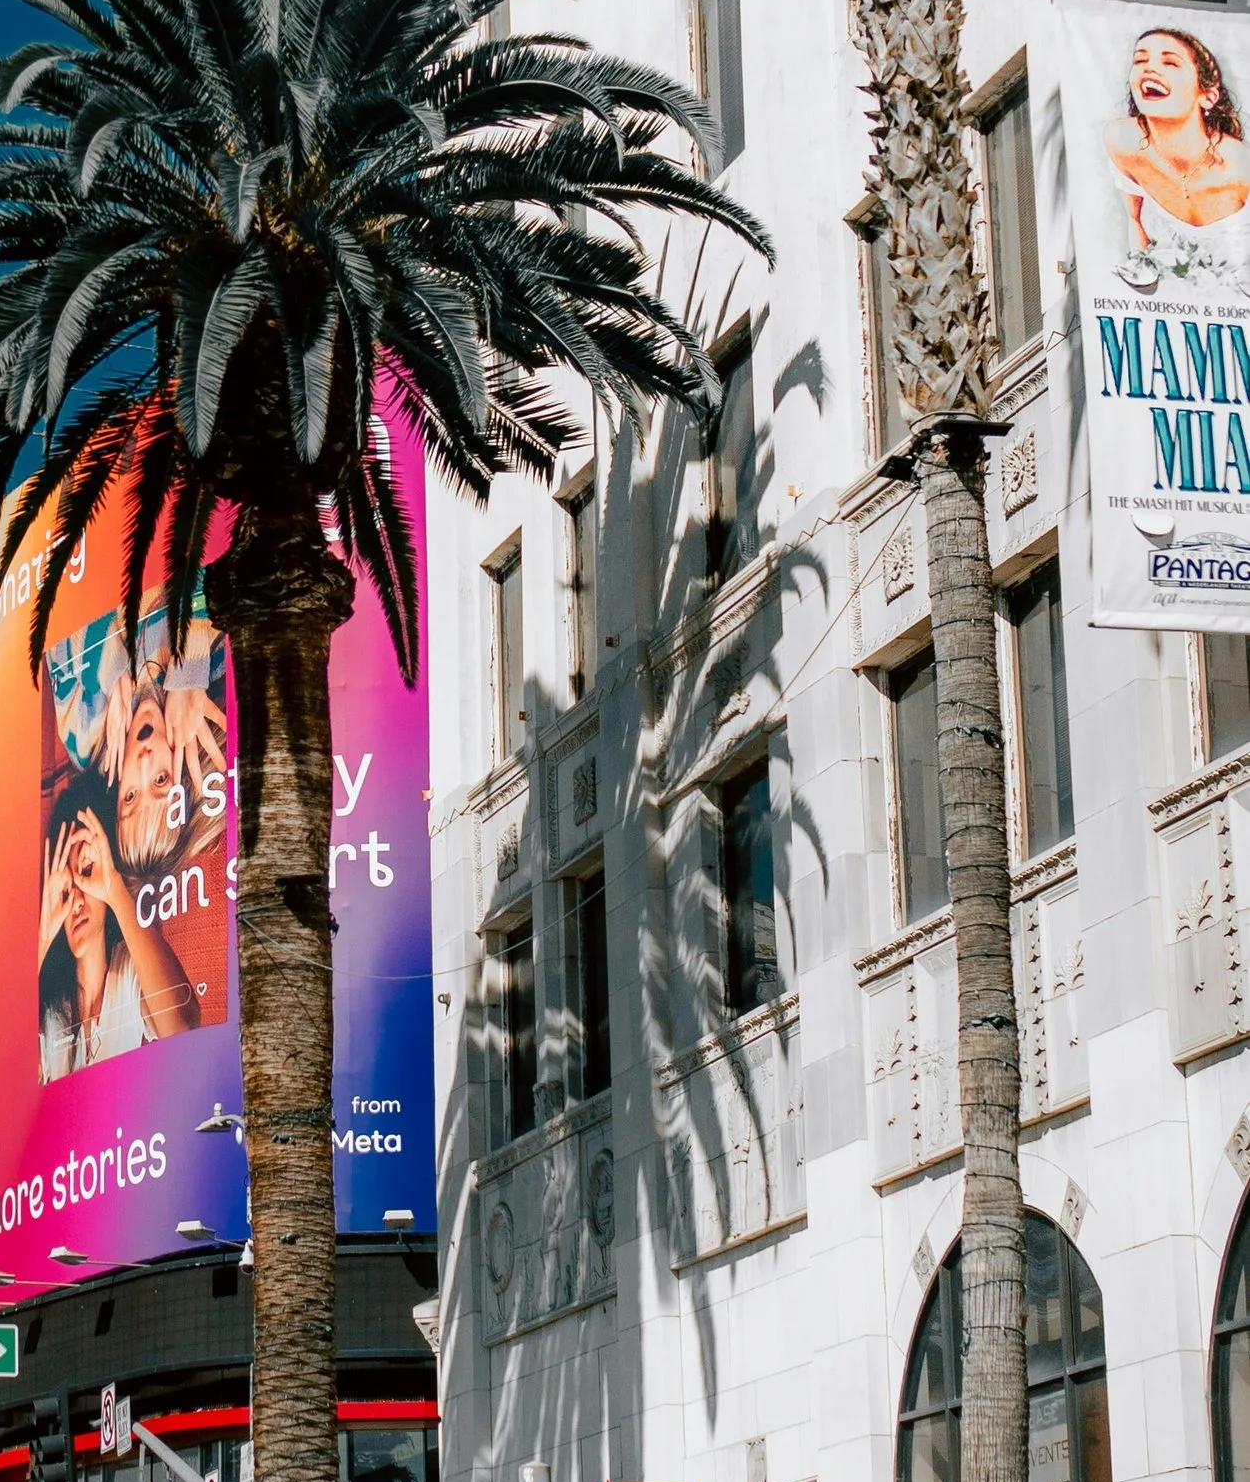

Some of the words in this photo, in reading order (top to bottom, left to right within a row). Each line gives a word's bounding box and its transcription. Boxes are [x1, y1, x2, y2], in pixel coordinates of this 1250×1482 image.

[1094, 298, 1130, 310] BENNY
[1134, 301, 1199, 315] ANDERSSON
[1203, 305, 1213, 317] &
[1109, 496, 1129, 509] THE
[1133, 497, 1172, 510] SMASH
[1175, 499, 1193, 512] HIT
[1197, 500, 1245, 515] MUSICAL
[166, 783, 186, 829] a
[136, 865, 209, 928] can
[351, 1096, 401, 1114] from
[332, 1129, 402, 1153] Meta
[52, 1127, 167, 1210] stories
[1030, 1439, 1070, 1468] VENTS
